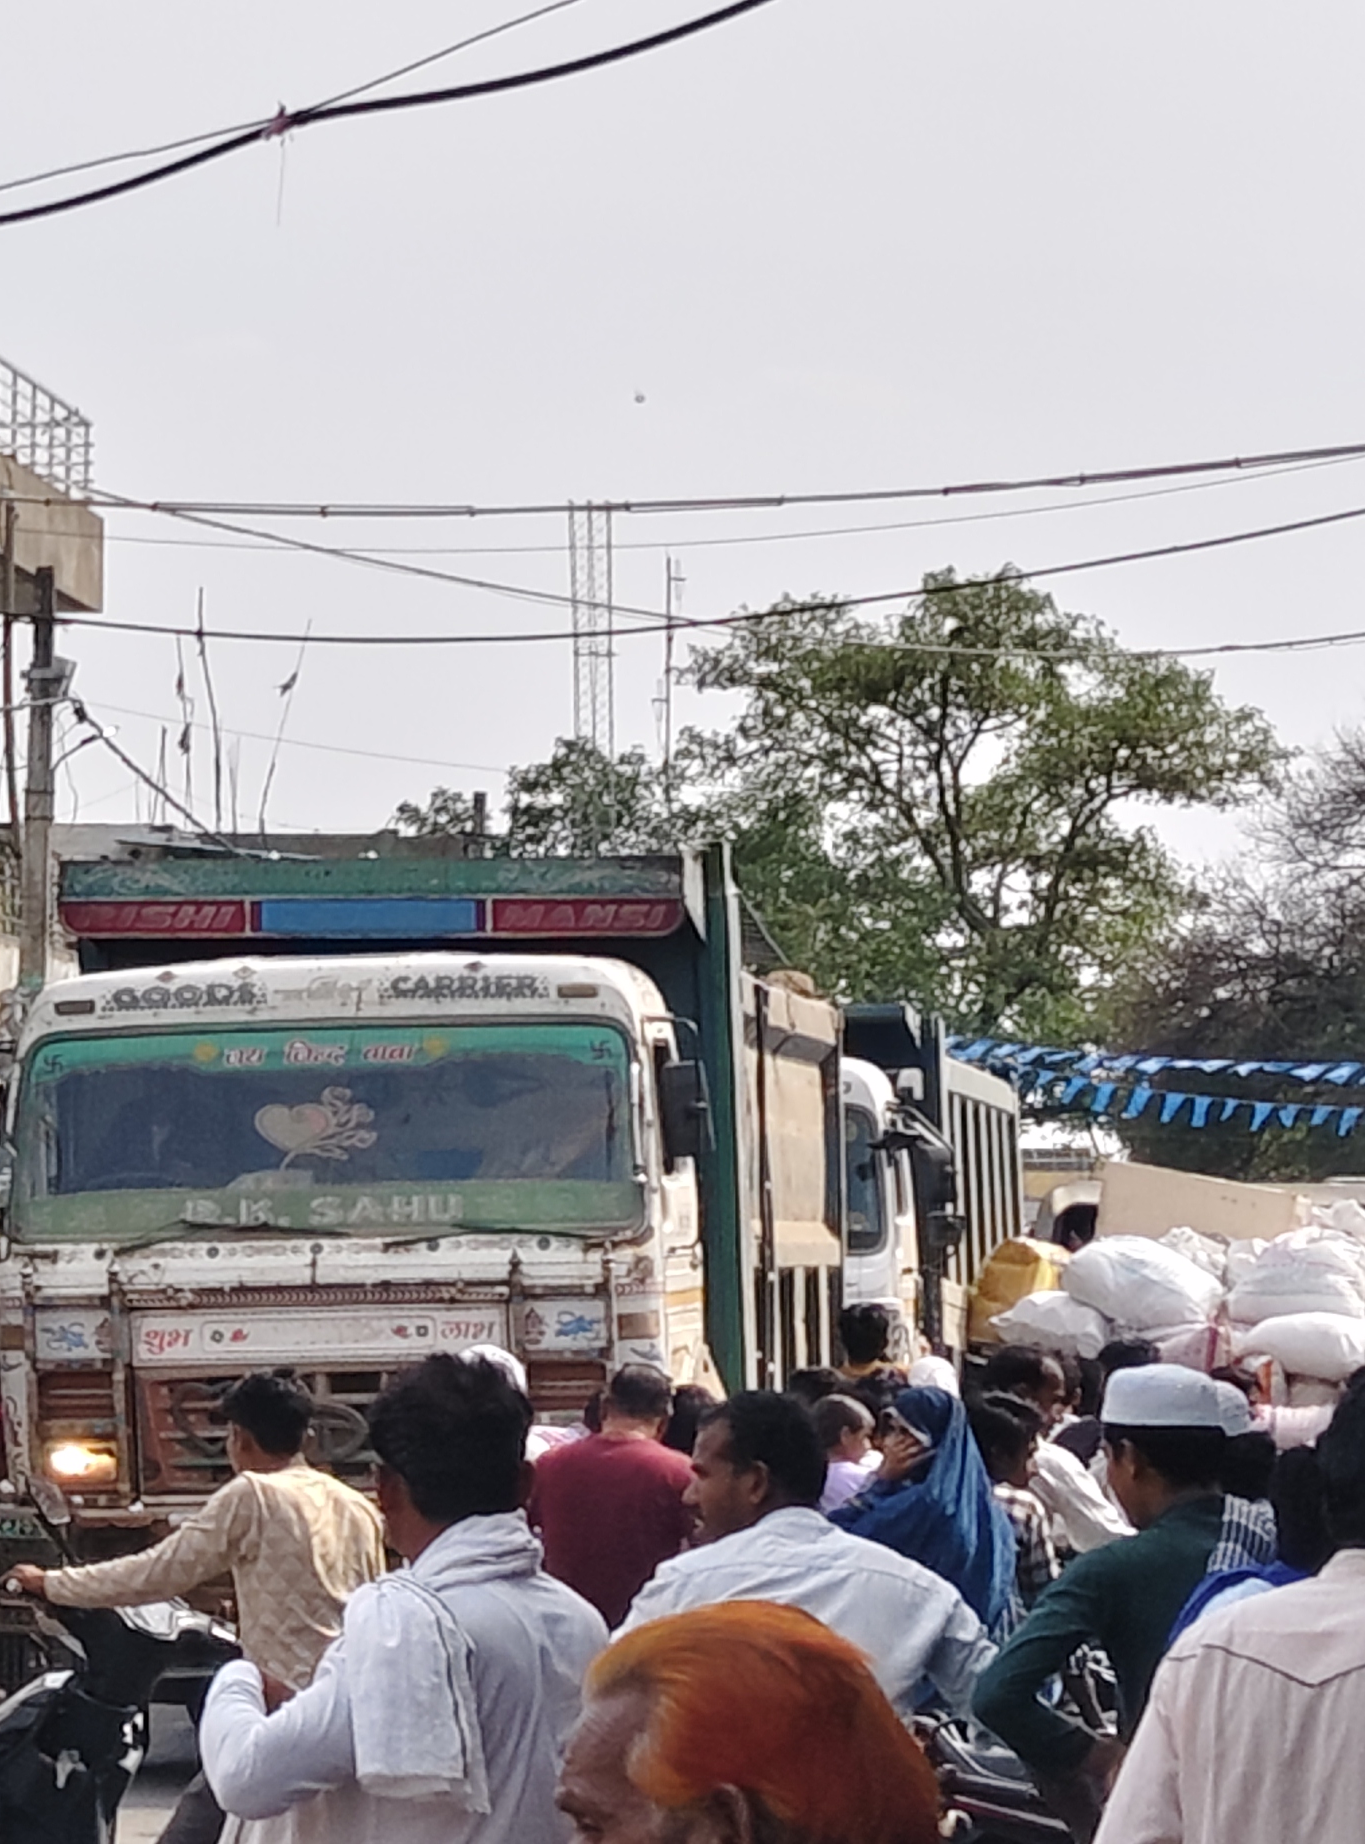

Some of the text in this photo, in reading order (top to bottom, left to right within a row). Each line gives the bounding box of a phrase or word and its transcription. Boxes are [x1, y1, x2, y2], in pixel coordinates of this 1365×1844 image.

[491, 904, 667, 930] MANSI
[112, 979, 258, 1013] GOODS
[388, 974, 542, 1004] CARRIER
[308, 1195, 464, 1226] SAHU
[143, 1319, 495, 1355] शुभ लाभ
